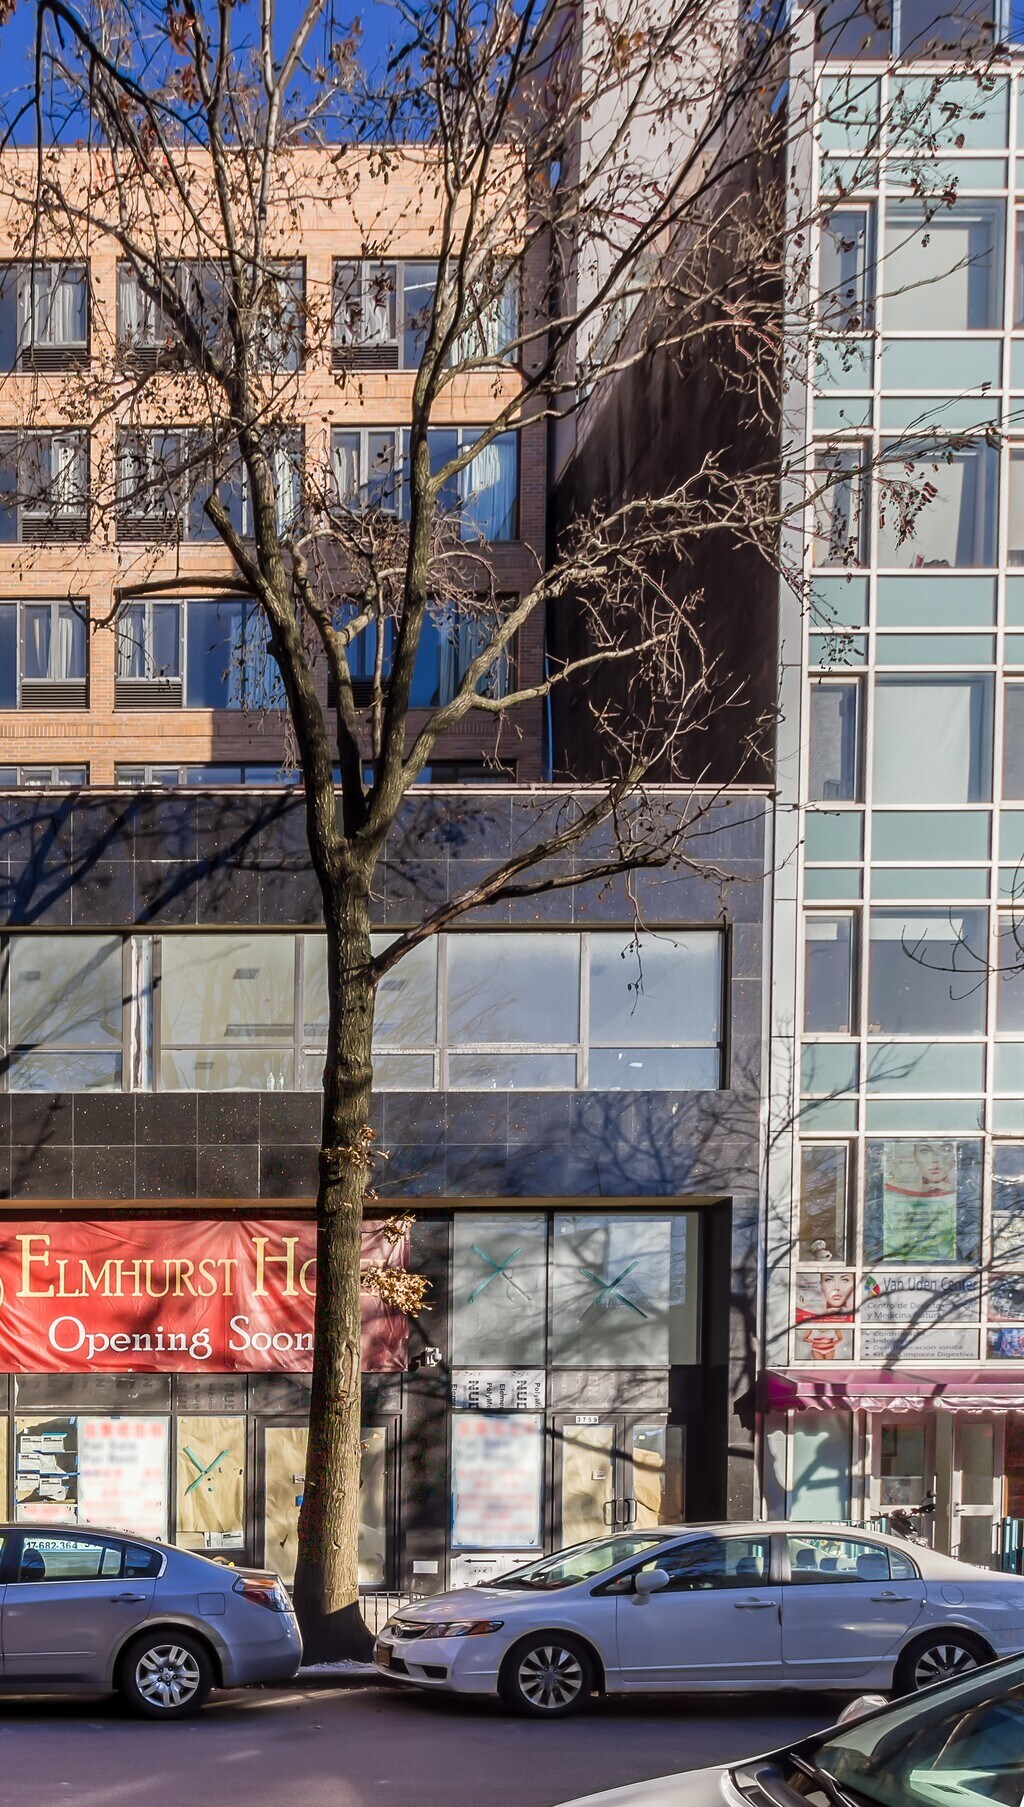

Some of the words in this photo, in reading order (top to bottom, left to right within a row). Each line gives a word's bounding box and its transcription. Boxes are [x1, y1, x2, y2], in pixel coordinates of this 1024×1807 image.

[883, 1276, 904, 1291] Van
[908, 1276, 936, 1291] Uden
[874, 1311, 912, 1319] Medicina
[914, 1311, 945, 1319] atural
[47, 1315, 212, 1360] Opening
[229, 1314, 314, 1352] Soon
